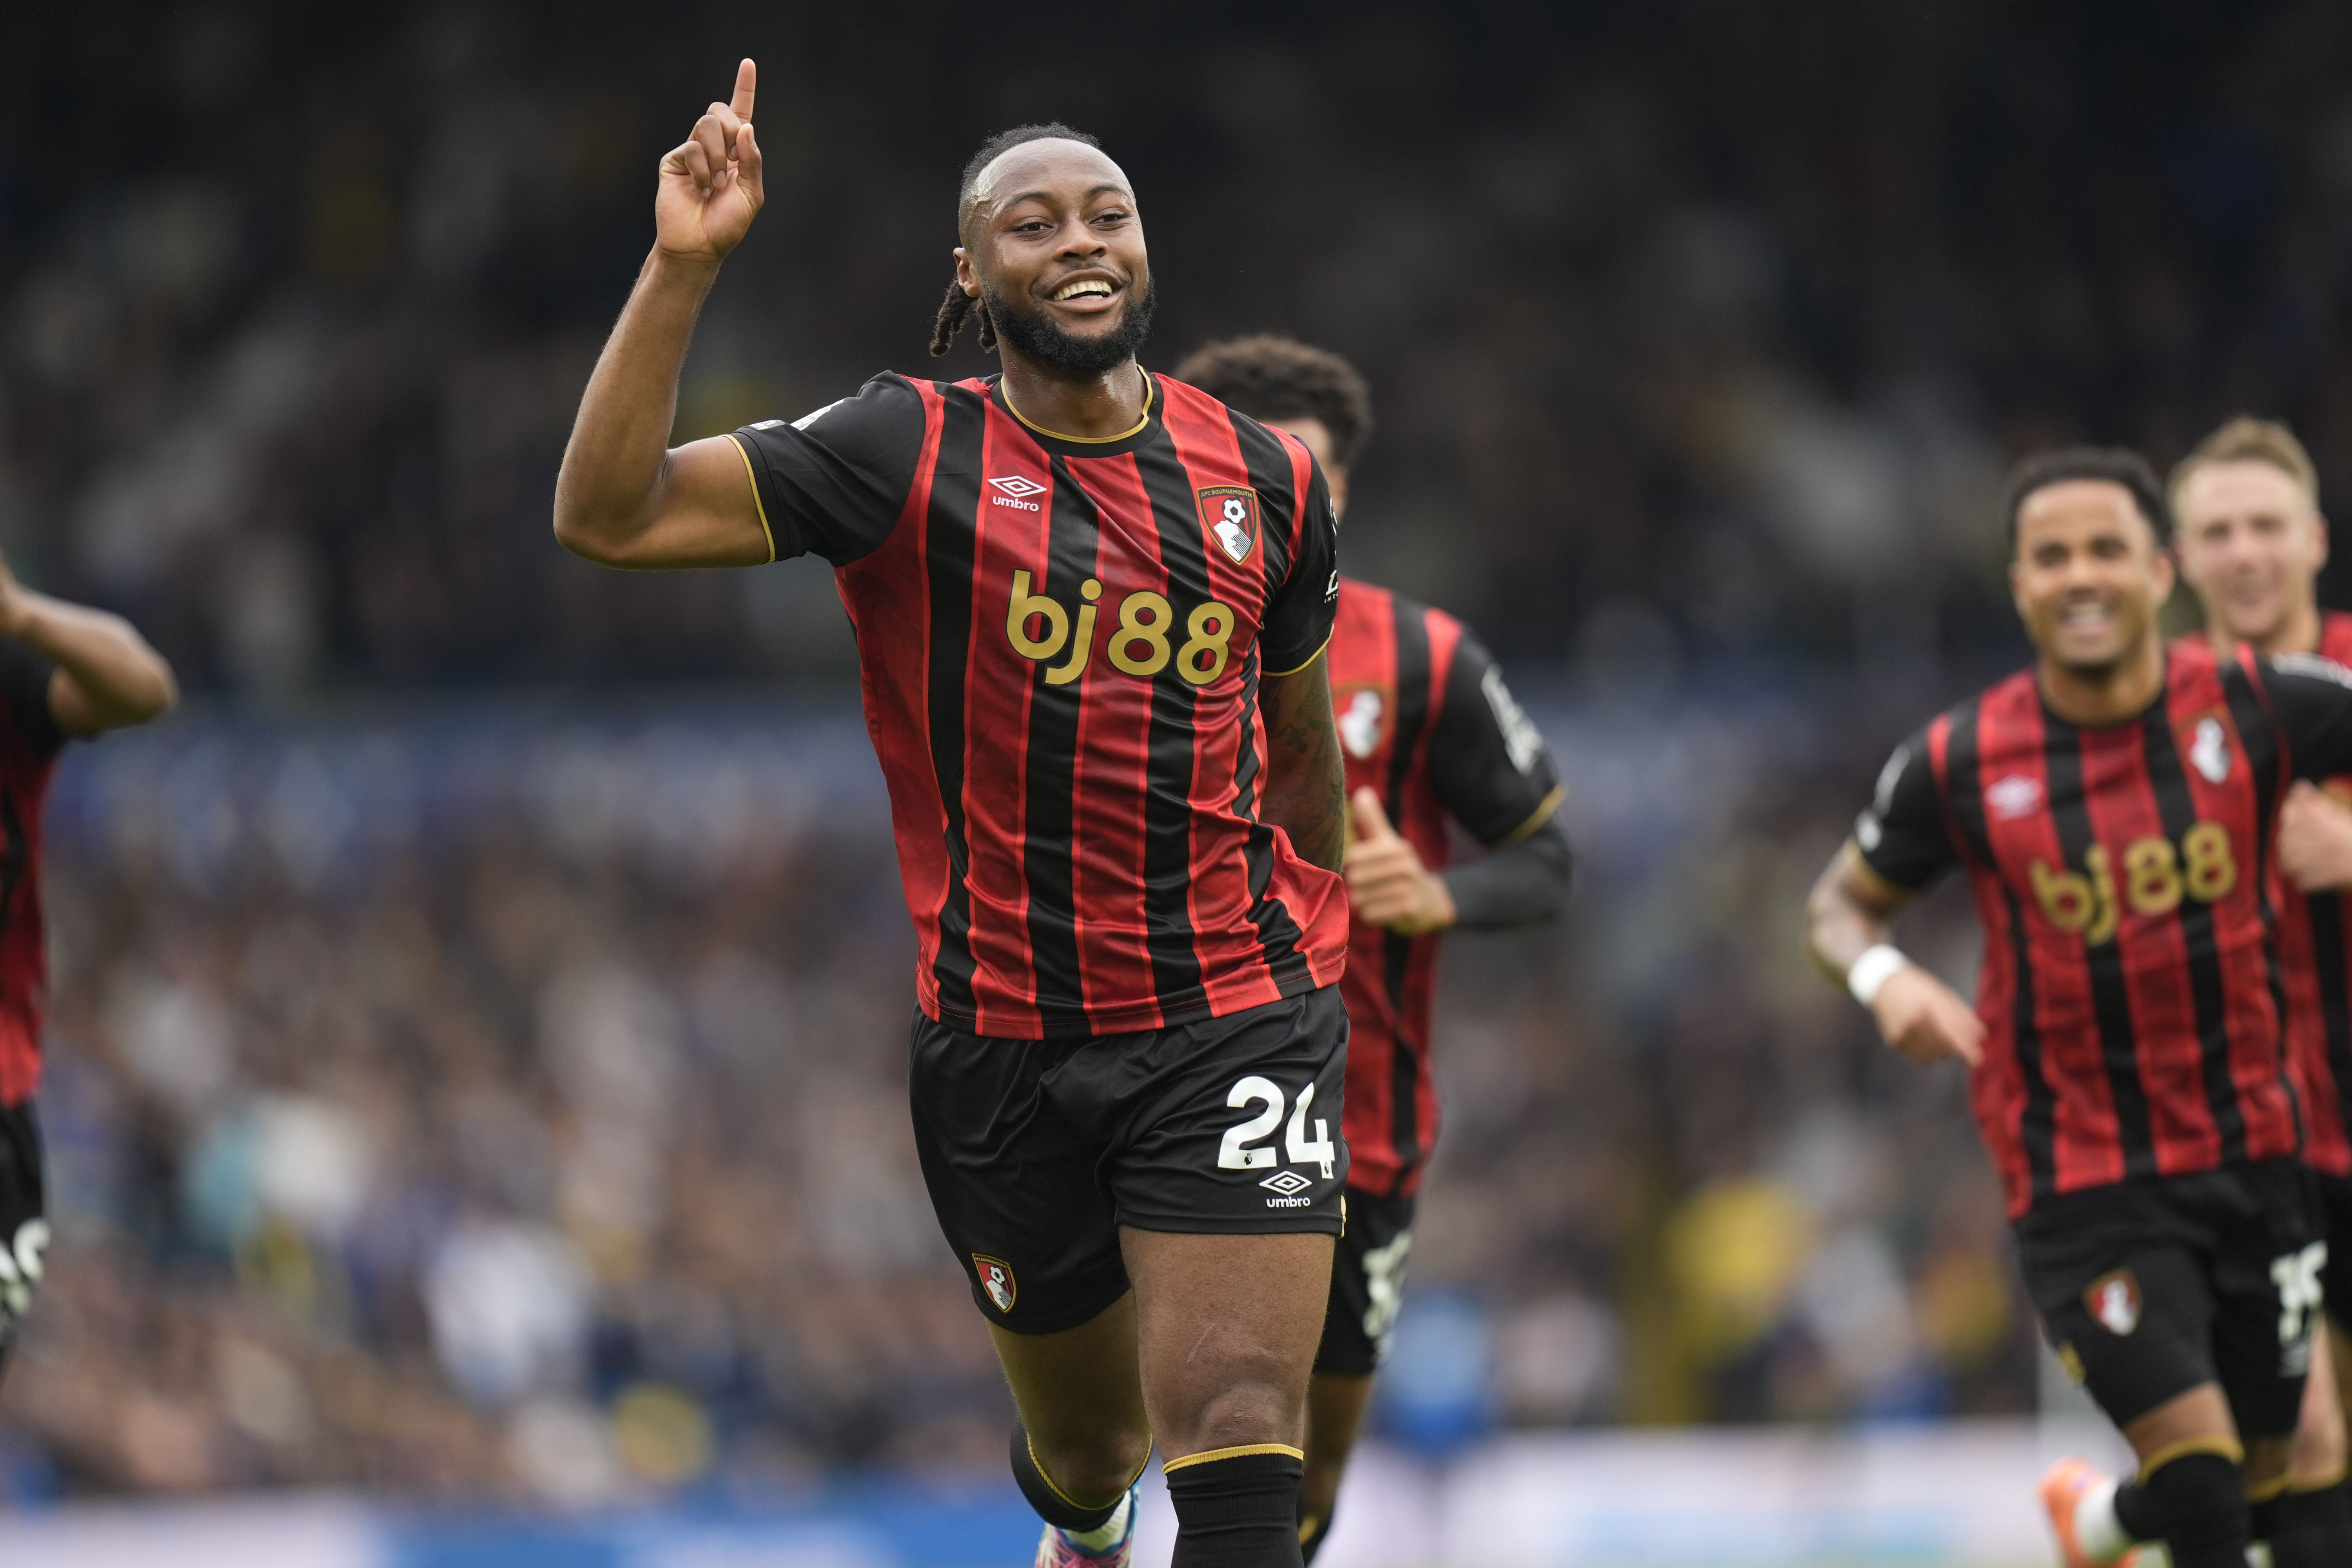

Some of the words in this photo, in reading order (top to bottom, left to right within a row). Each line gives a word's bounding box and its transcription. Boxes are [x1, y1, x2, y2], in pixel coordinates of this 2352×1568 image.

[993, 496, 1039, 512] umbro
[1211, 489, 1252, 498] BOURNEMOUTH
[1005, 568, 1235, 686] bj88
[2027, 820, 2236, 947] bj88
[1218, 1076, 1335, 1179] 24
[1266, 1196, 1310, 1208] umbro
